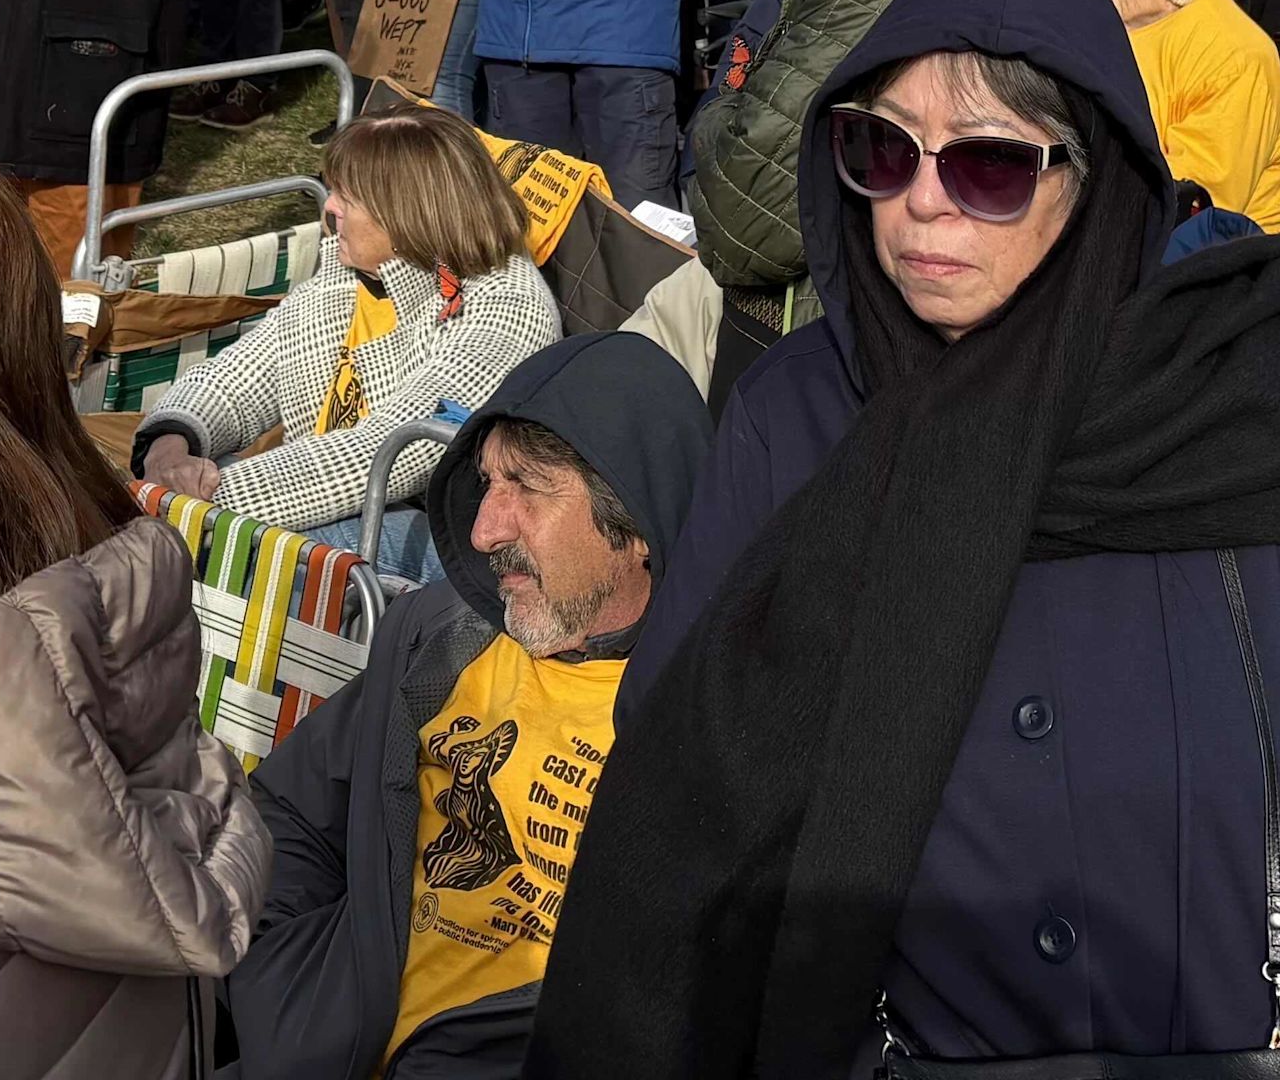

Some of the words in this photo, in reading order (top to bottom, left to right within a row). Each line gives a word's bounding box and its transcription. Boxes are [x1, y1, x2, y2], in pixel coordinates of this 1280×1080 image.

[380, 13, 427, 45] WEPT
[542, 754, 586, 788] cast
[528, 781, 559, 810] the
[506, 871, 542, 903] has
[438, 925, 461, 941] public
[466, 929, 479, 939] for
[490, 916, 519, 936] Mary
